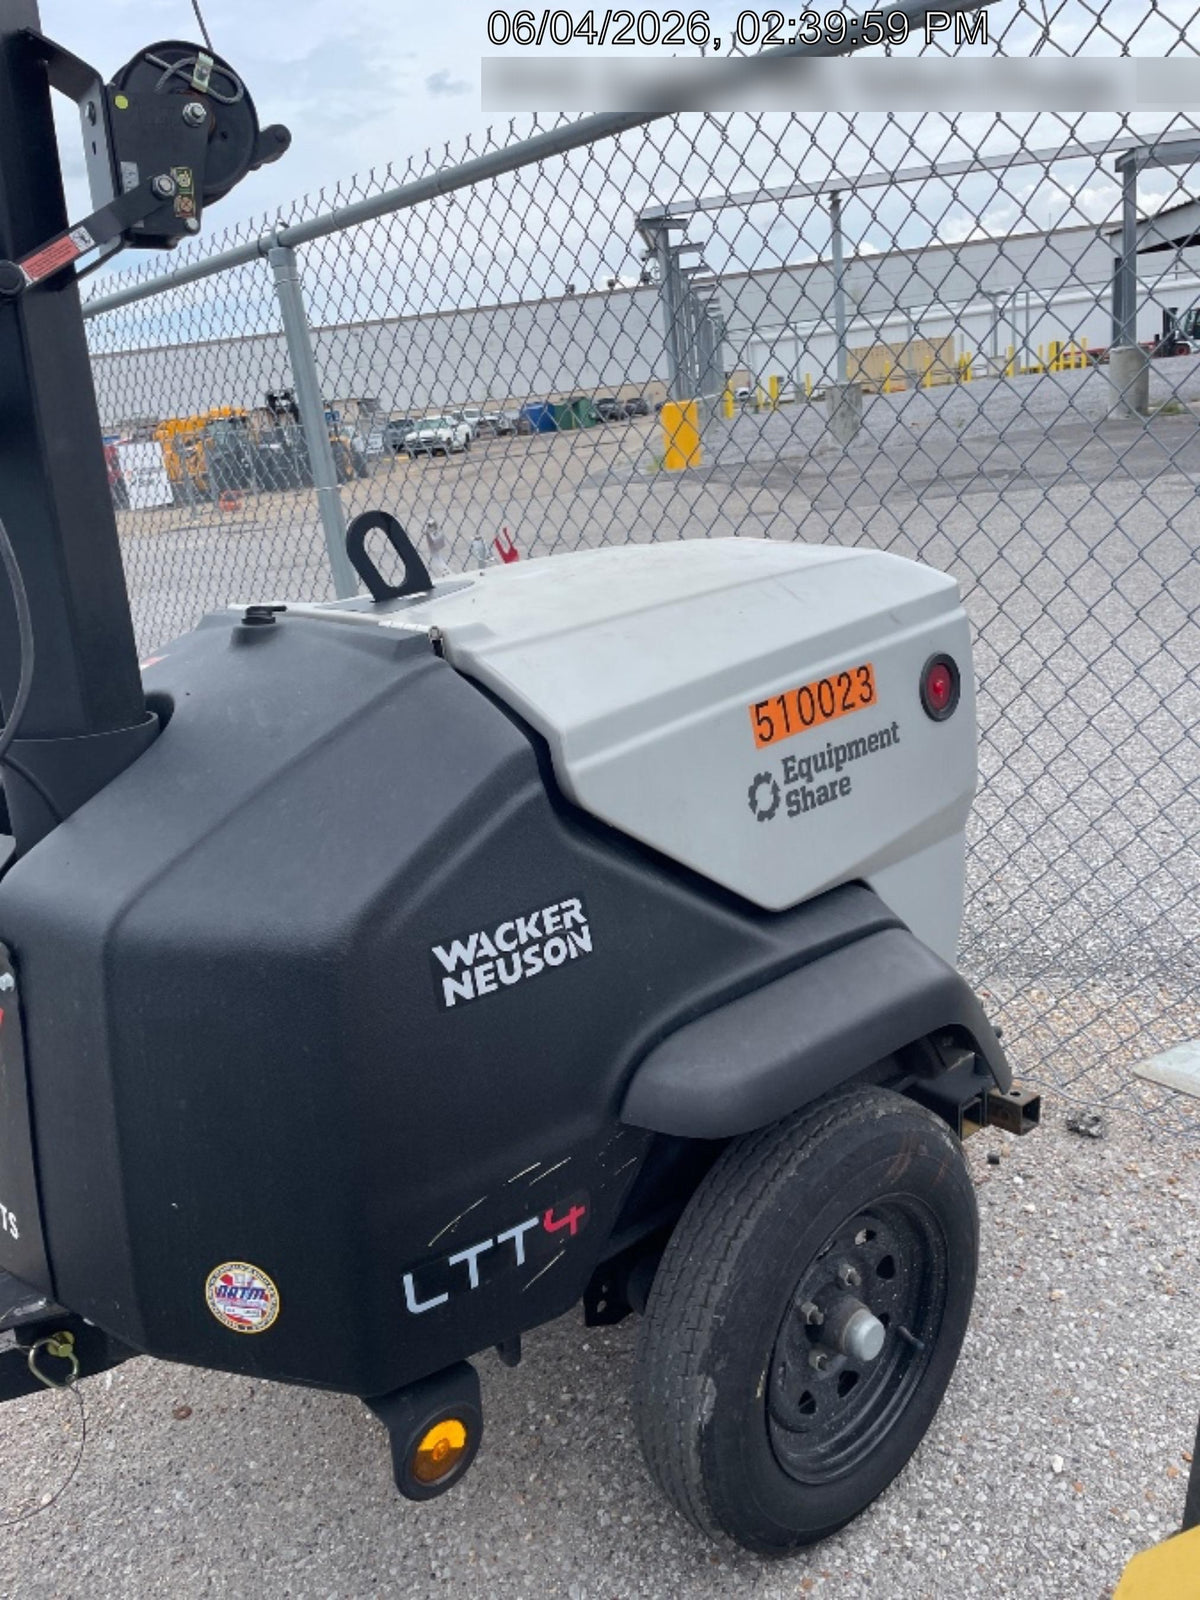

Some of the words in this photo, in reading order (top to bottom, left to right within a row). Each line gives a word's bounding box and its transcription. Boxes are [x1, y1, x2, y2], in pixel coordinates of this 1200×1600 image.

[755, 665, 874, 742] 510023
[781, 721, 901, 785] Equipment
[785, 776, 853, 818] Share
[431, 897, 588, 973] WACKER
[442, 925, 593, 1007] NEUSON
[402, 1205, 586, 1315] LTT4
